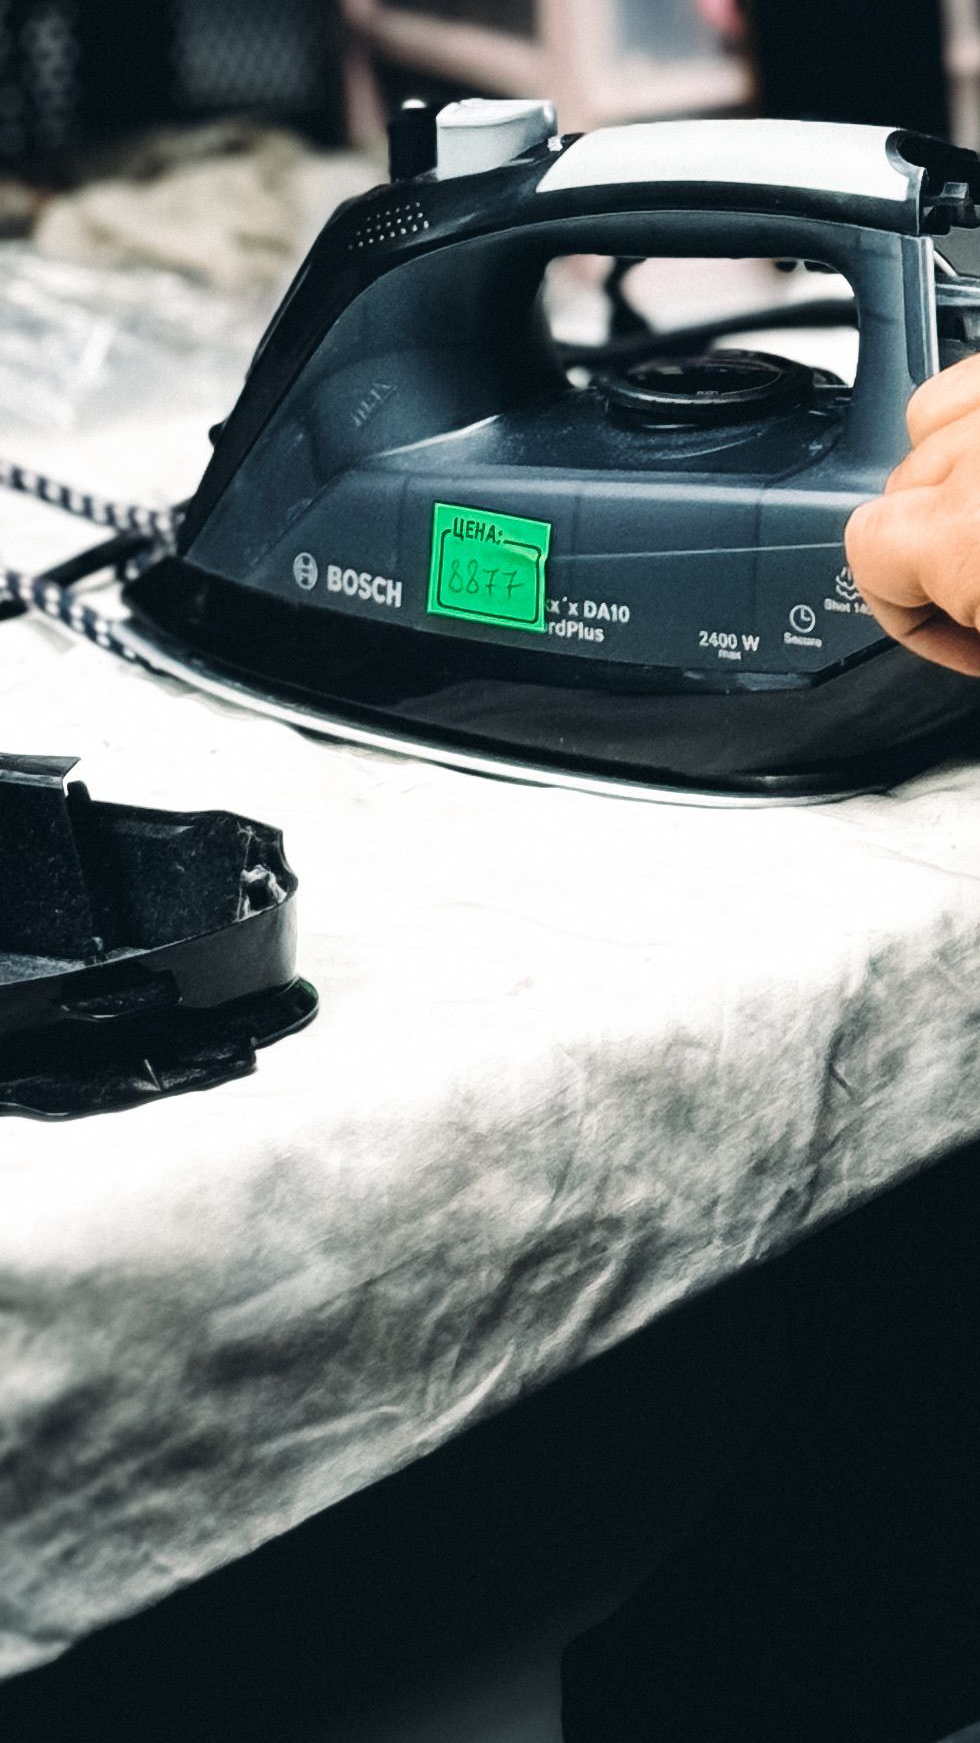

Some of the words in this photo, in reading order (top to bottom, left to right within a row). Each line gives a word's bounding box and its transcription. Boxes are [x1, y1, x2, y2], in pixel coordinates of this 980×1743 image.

[453, 517, 504, 545] ЦЕНА:
[327, 564, 402, 608] BOSCH
[449, 559, 525, 599] 8877
[583, 600, 630, 624] DA10
[547, 619, 605, 643] rdPlus
[699, 630, 738, 650] 2400
[741, 634, 760, 652] W
